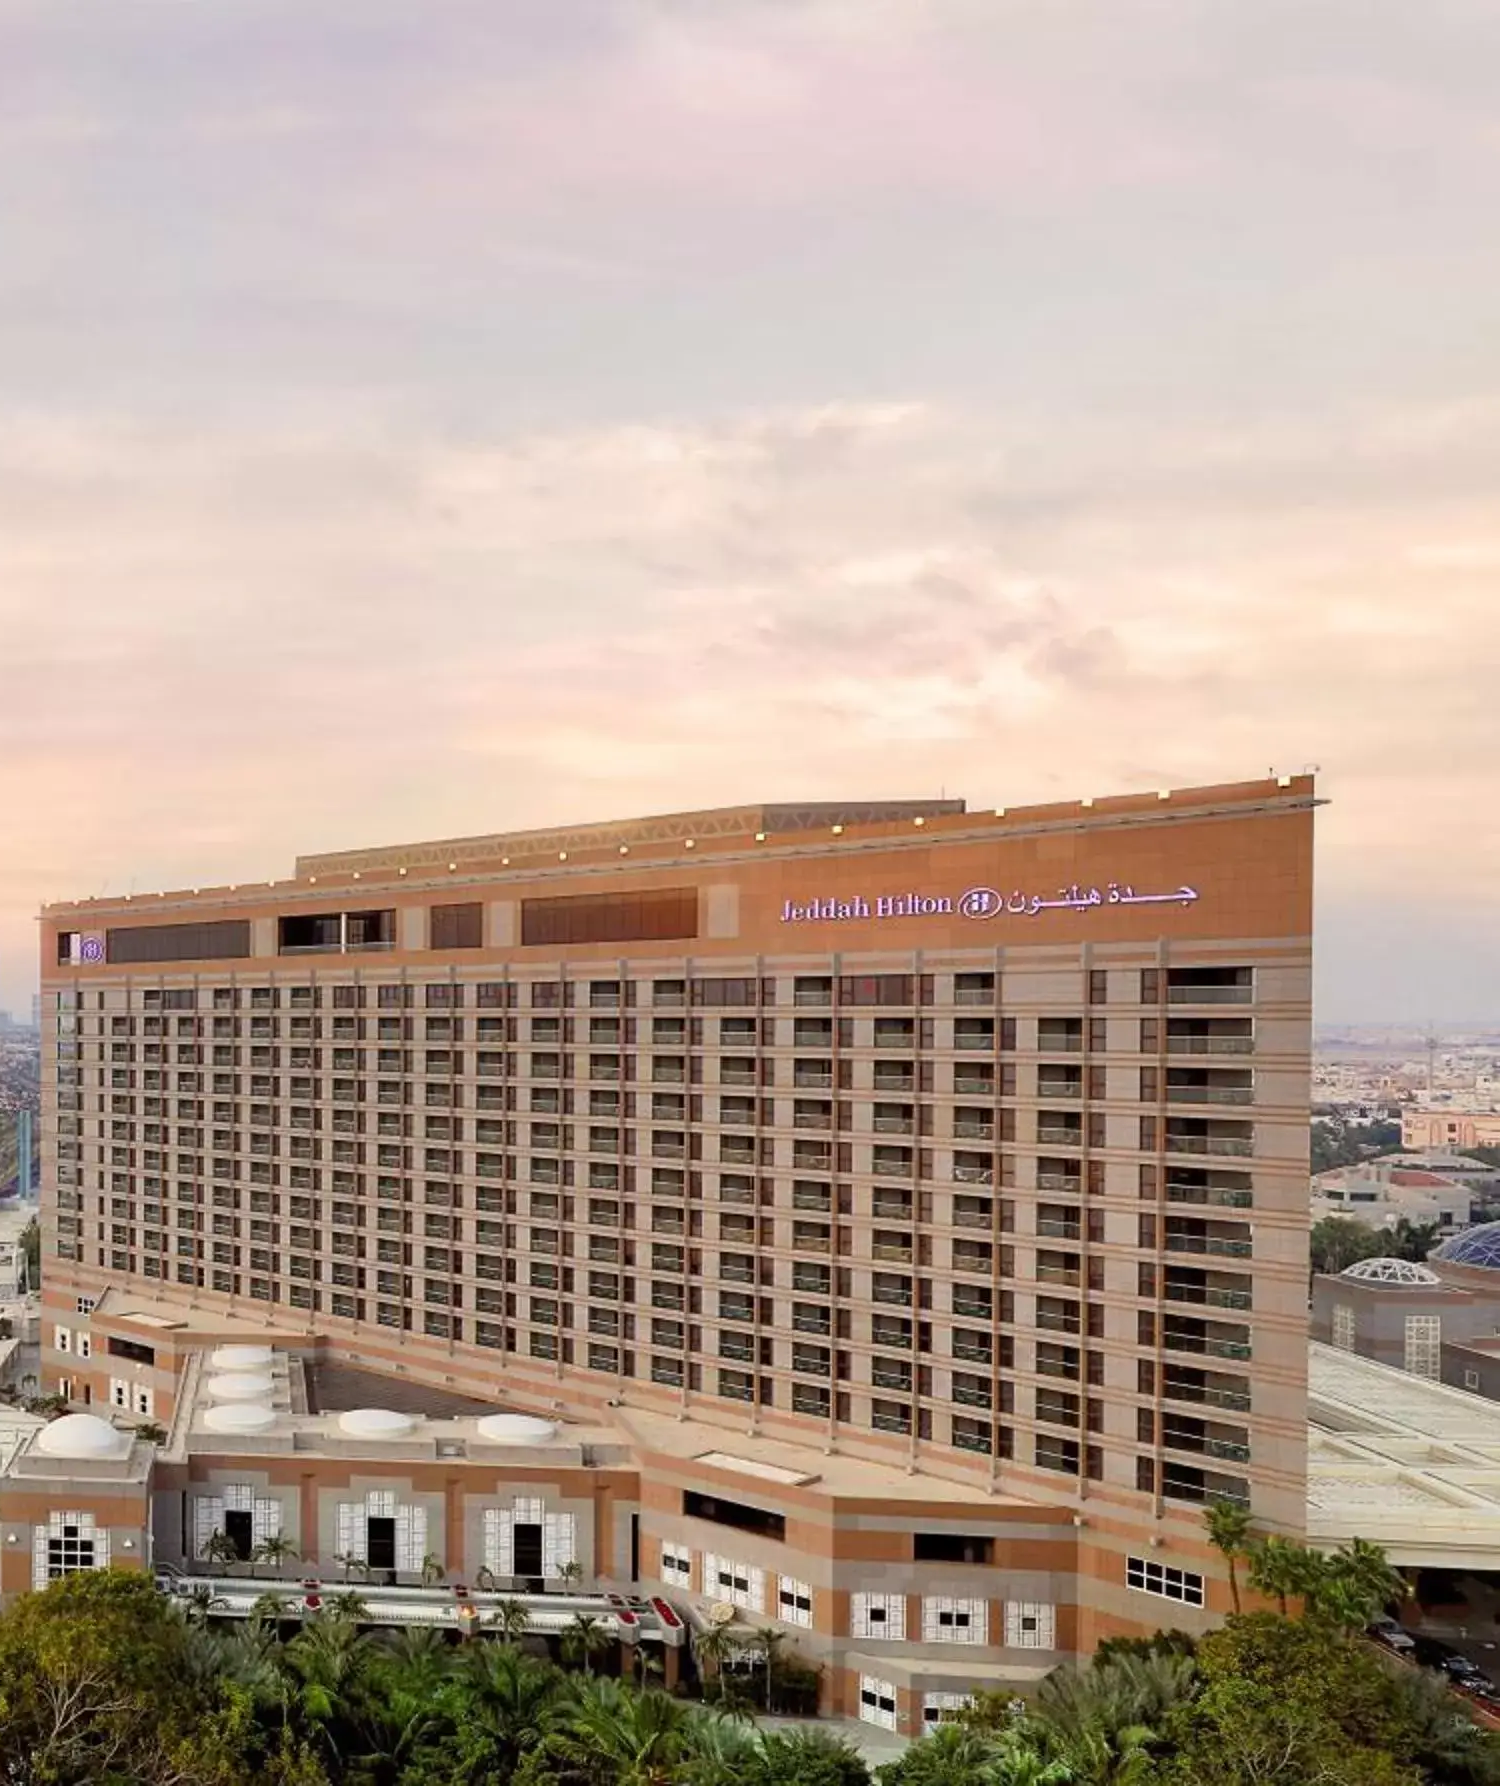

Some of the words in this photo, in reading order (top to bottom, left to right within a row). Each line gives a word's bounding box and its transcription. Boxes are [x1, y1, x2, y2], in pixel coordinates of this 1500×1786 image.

[779, 895, 870, 922] Jeddah
[875, 892, 954, 918] Hilton
[1006, 883, 1102, 915] هيلتون
[1107, 882, 1198, 907] جدة
